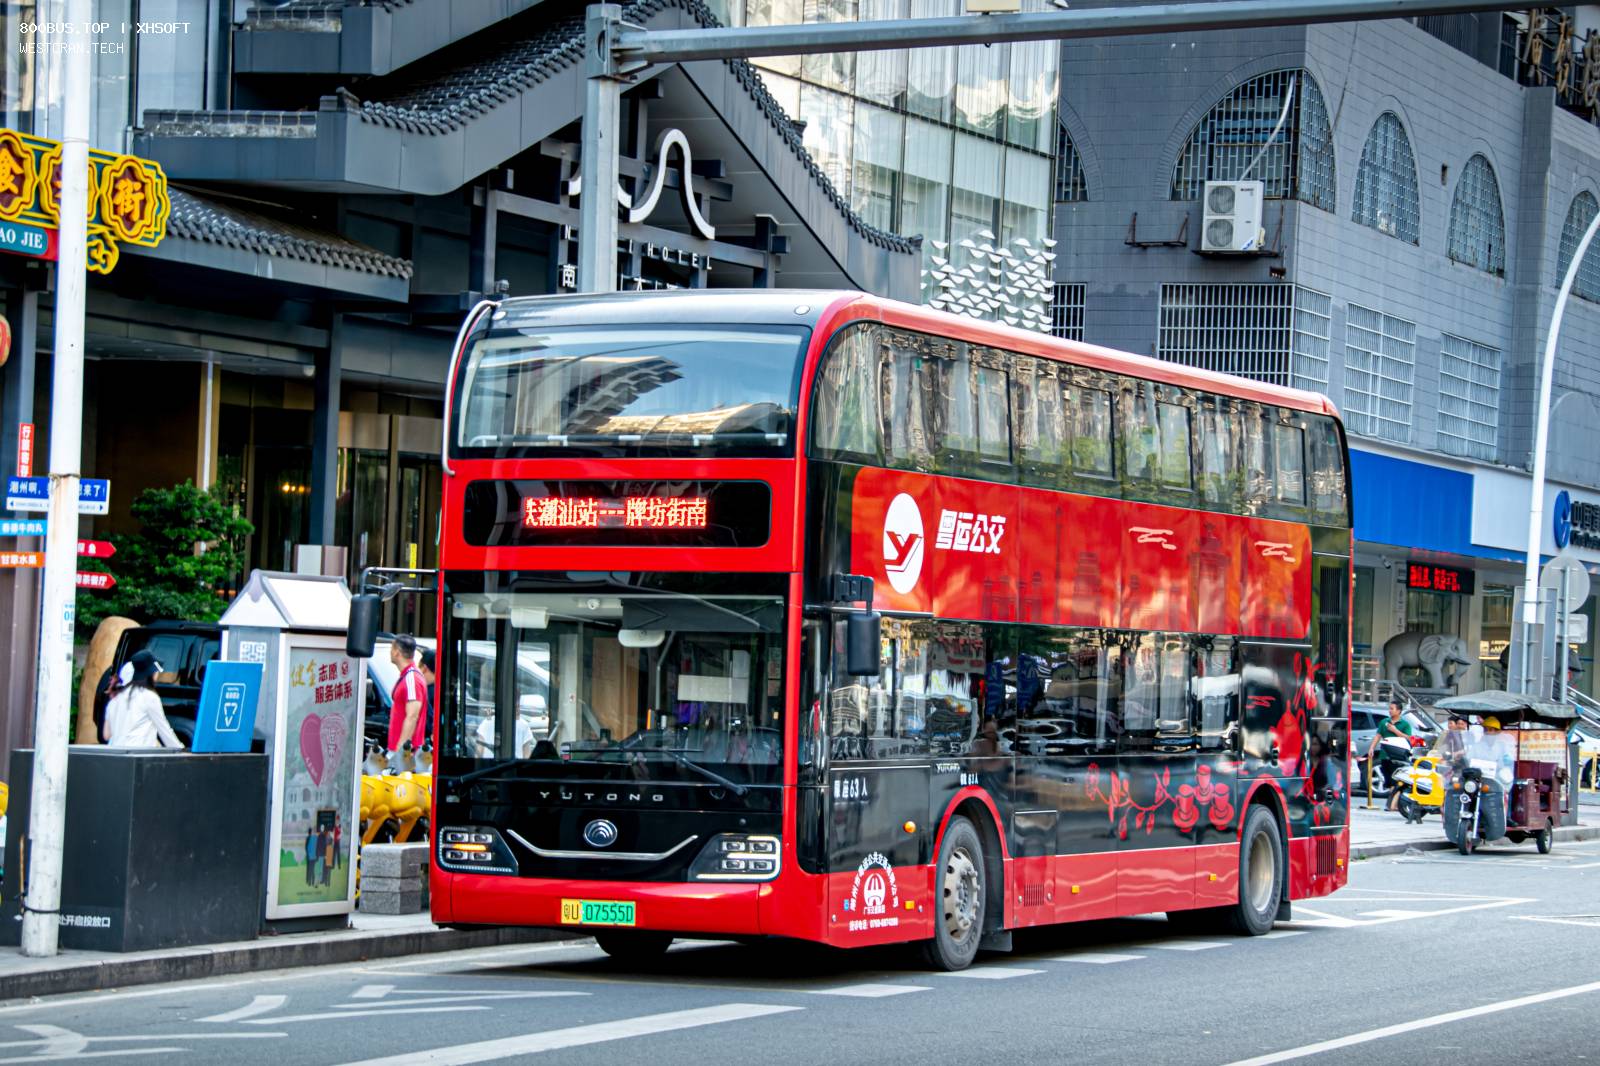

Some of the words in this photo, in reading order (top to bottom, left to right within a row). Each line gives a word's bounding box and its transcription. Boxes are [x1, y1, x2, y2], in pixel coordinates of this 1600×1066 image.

[21, 231, 43, 249] JIE
[647, 242, 712, 270] HOTEL
[935, 508, 1007, 555] 粤运公交
[318, 662, 338, 682] 志愿
[315, 680, 353, 704] 服务体系
[539, 791, 664, 802] YUTONG
